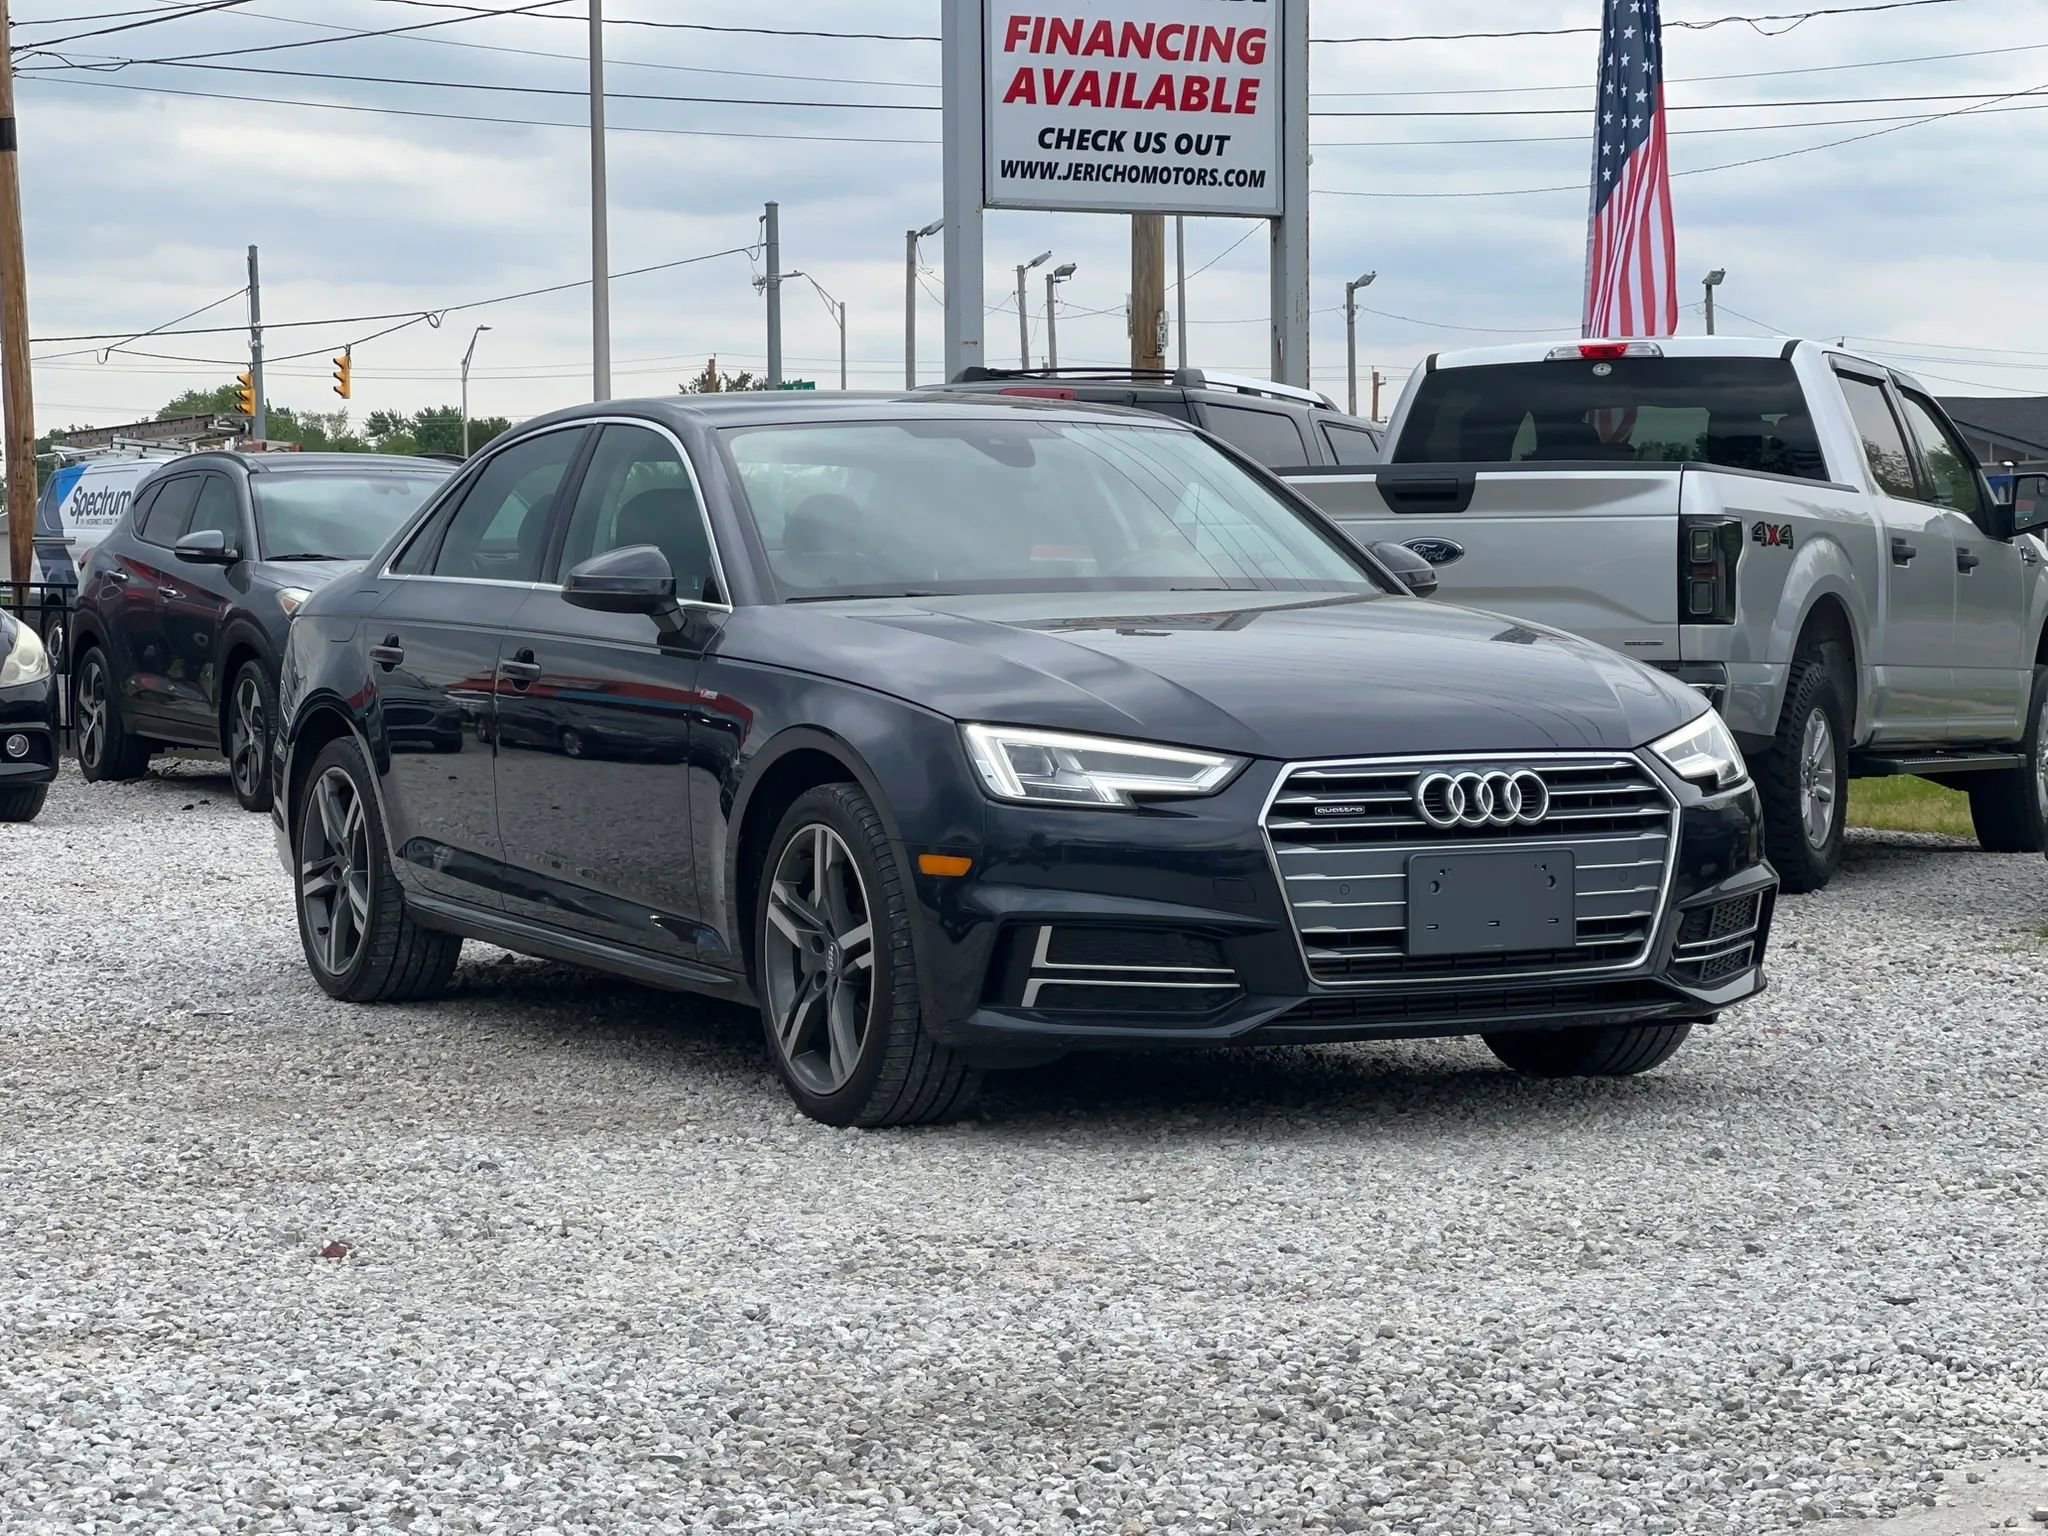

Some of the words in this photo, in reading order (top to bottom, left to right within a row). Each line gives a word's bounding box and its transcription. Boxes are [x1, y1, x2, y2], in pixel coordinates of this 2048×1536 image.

[1004, 15, 1267, 65] FINANCING
[1003, 67, 1260, 115] AVAILABLE
[1038, 127, 1128, 153] CHECK
[1133, 131, 1167, 154] US
[1174, 133, 1231, 156] OUT
[1000, 159, 1266, 188] WWW.JERICHOMOTORS.COM
[70, 485, 132, 525] Spectrum
[1412, 543, 1448, 561] Ford
[1317, 807, 1363, 815] quattro
